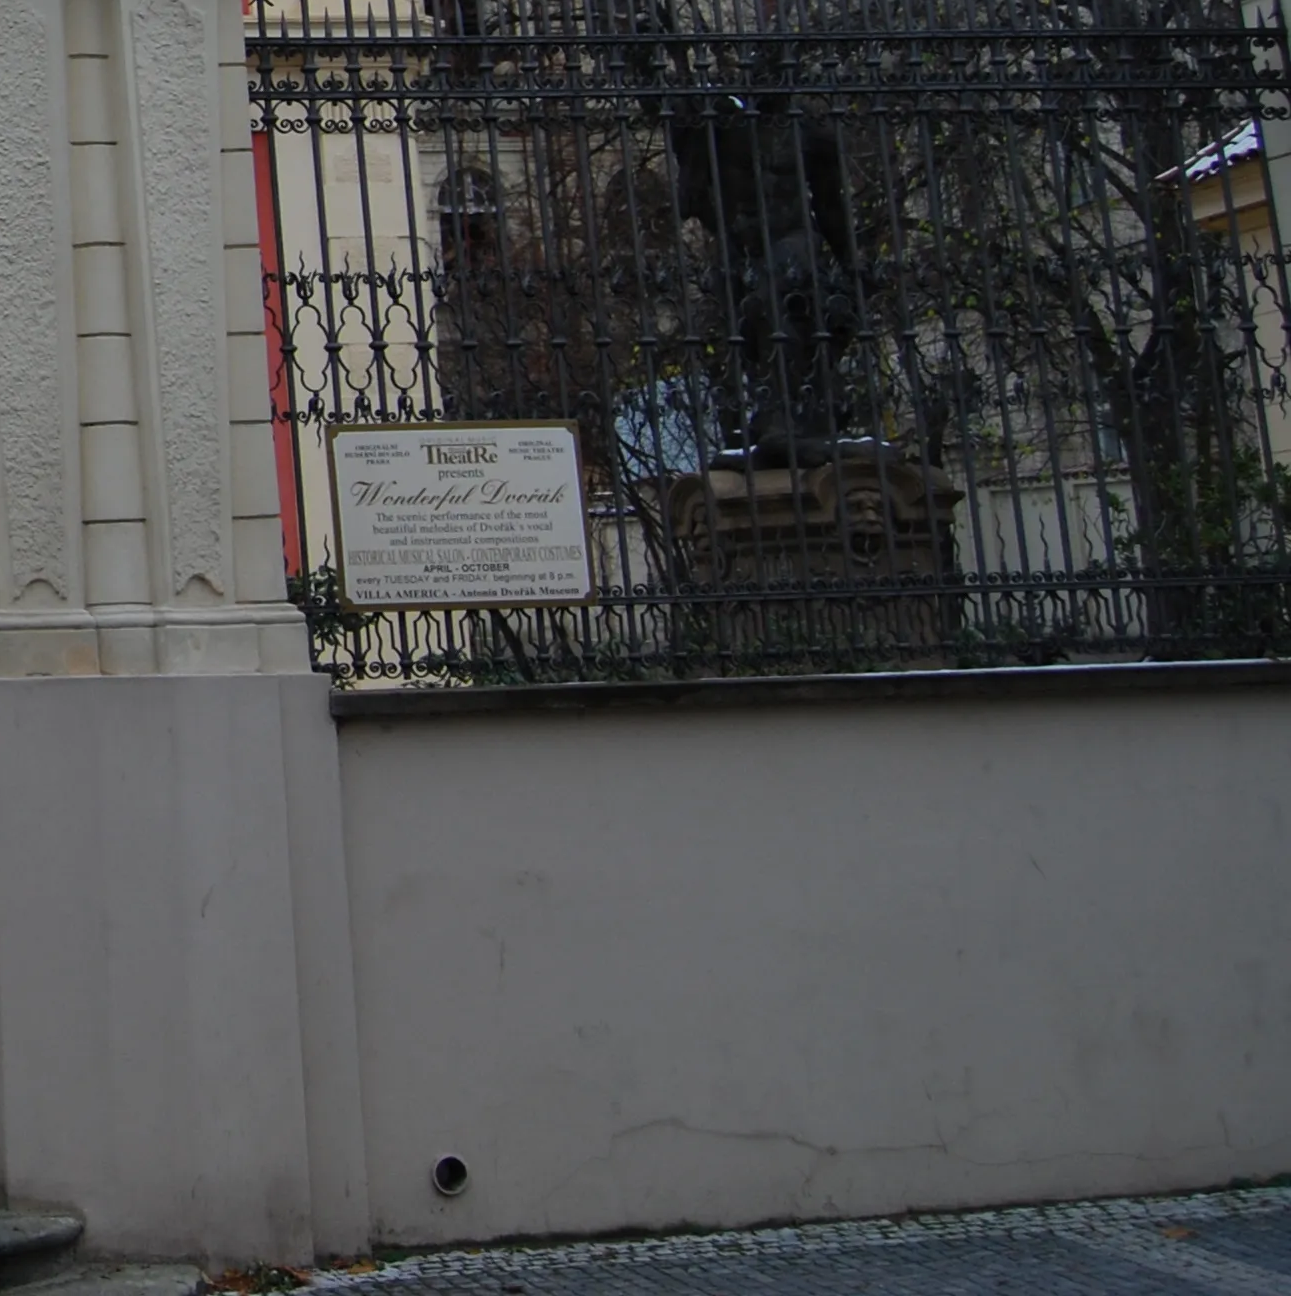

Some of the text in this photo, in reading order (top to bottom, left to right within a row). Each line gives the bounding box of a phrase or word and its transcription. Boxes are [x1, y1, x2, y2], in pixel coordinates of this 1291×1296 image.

[438, 468, 485, 481] presents
[349, 479, 569, 511] Wonderful Dvořák
[376, 509, 548, 522] The scenic performance of the most
[373, 524, 417, 535] beautiful
[420, 523, 464, 534] melodies
[467, 523, 477, 532] of
[528, 521, 553, 531] vocal
[389, 534, 539, 546] and instrumental compositions
[348, 550, 397, 566] HISTORICAL
[399, 549, 435, 564] MUSICAL
[437, 548, 465, 563] SALON
[472, 547, 537, 562] CONTEMPORARY
[538, 545, 582, 561] COSTUMES
[423, 565, 452, 573] APRIL
[461, 563, 510, 572] OCTOBER
[356, 577, 381, 586] every
[384, 574, 430, 584] TUESDAY
[433, 574, 449, 583] and
[493, 573, 535, 583] beginning
[538, 571, 547, 581] at
[356, 590, 392, 600] VILLA
[395, 588, 449, 599] AMERICA
[539, 586, 579, 595] Museum
